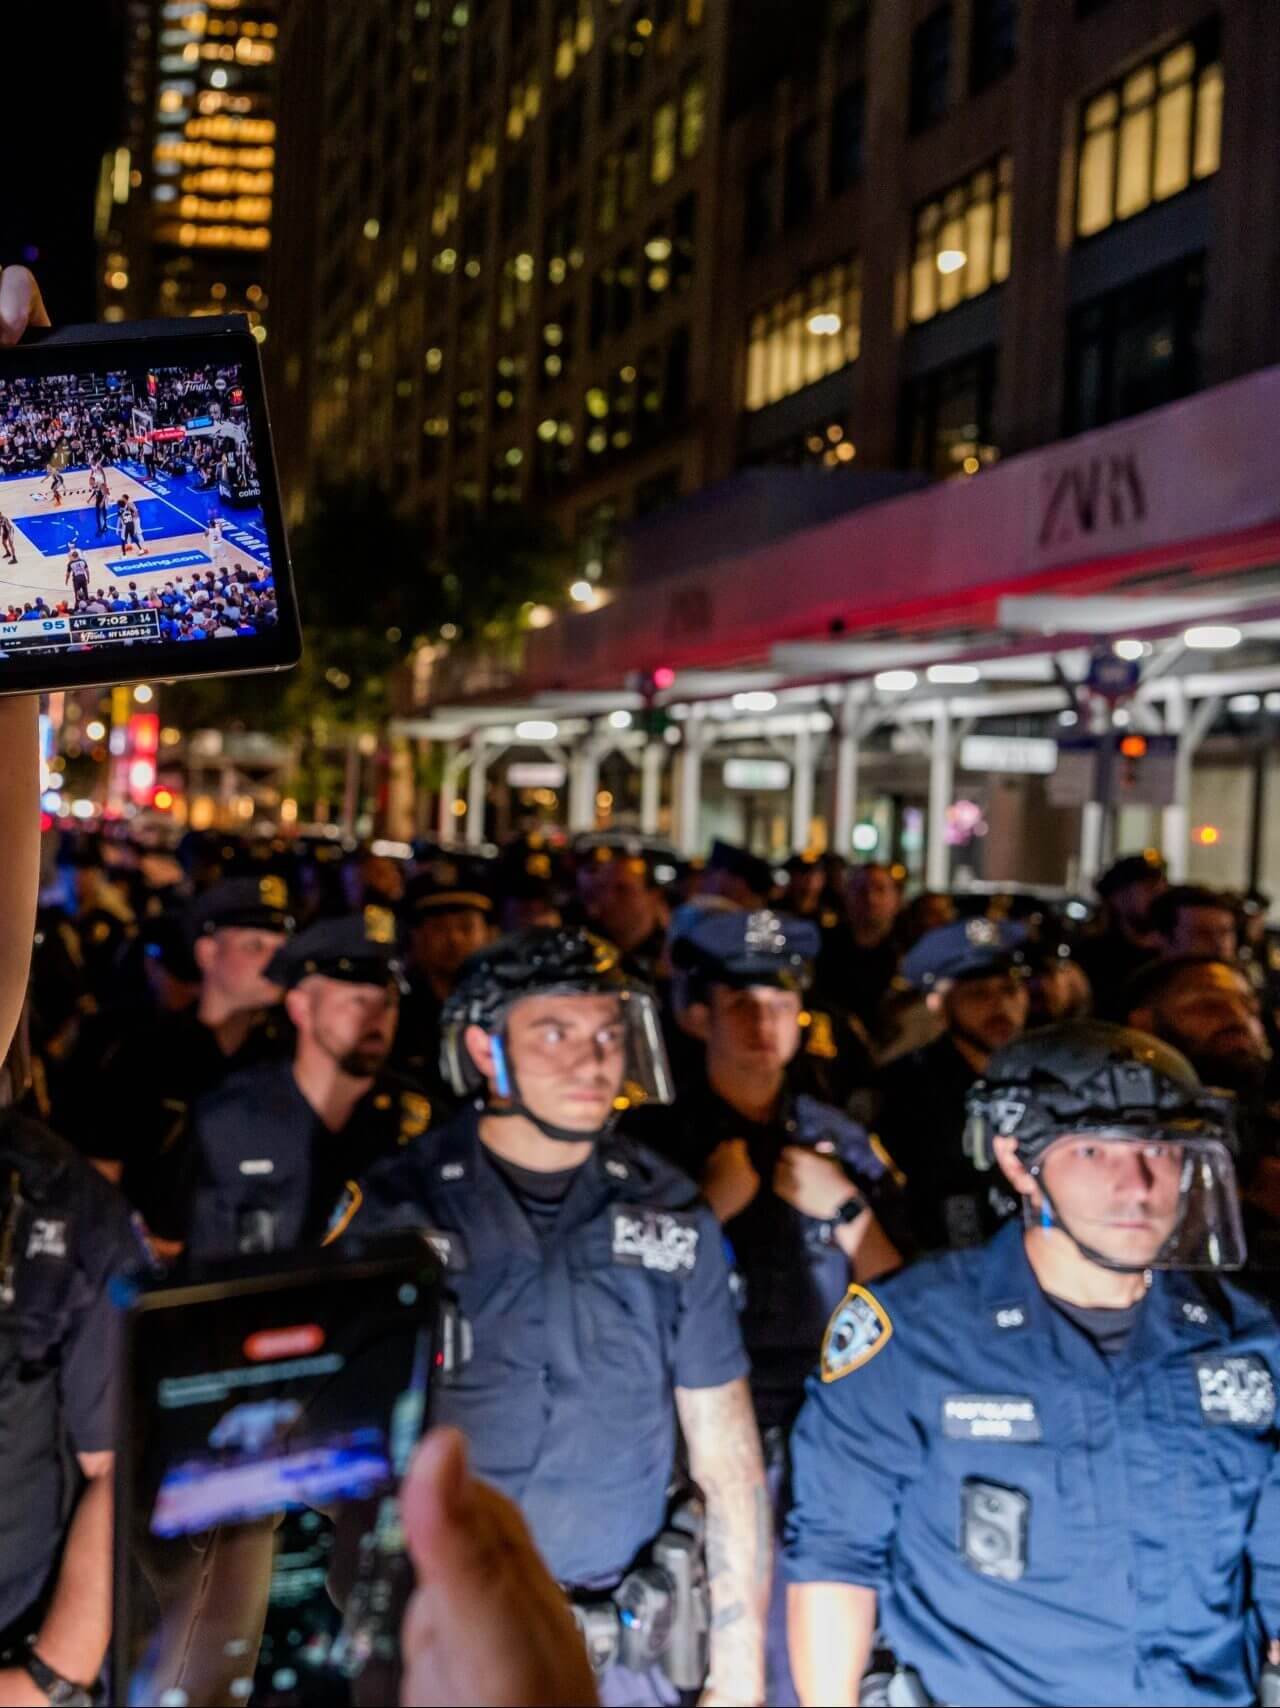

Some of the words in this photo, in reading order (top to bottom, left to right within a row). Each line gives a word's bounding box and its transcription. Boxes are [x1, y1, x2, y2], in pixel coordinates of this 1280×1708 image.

[182, 380, 213, 397] Finals
[229, 531, 269, 550] YORK
[2, 625, 18, 633] NY
[42, 620, 66, 631] 95
[97, 615, 128, 626] 7:02
[140, 613, 151, 623] 14
